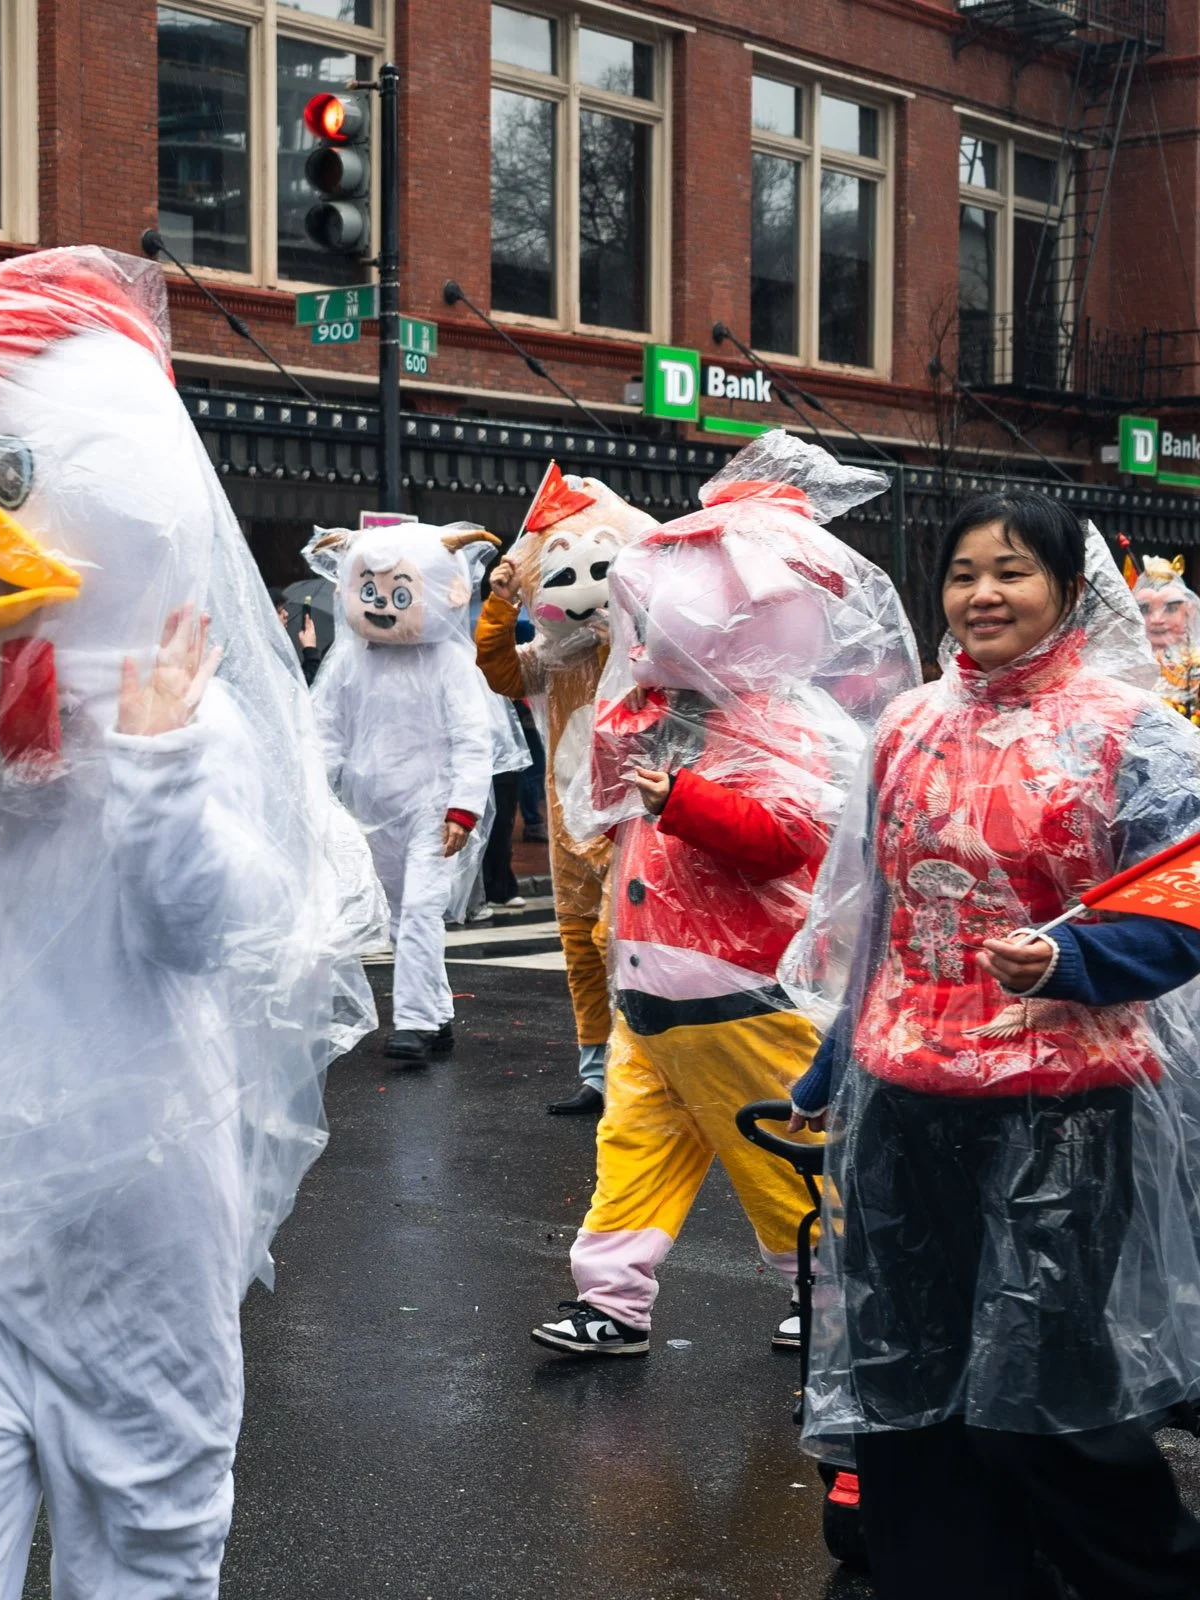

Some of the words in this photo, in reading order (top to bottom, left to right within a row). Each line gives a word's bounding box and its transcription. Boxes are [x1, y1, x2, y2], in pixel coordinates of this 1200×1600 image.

[316, 294, 330, 319] 7
[346, 290, 359, 304] St
[318, 322, 354, 341] 900
[405, 353, 427, 374] 600
[659, 360, 694, 404] TD
[707, 365, 772, 403] Bank
[1132, 429, 1153, 462] TD
[1147, 872, 1200, 894] MG
